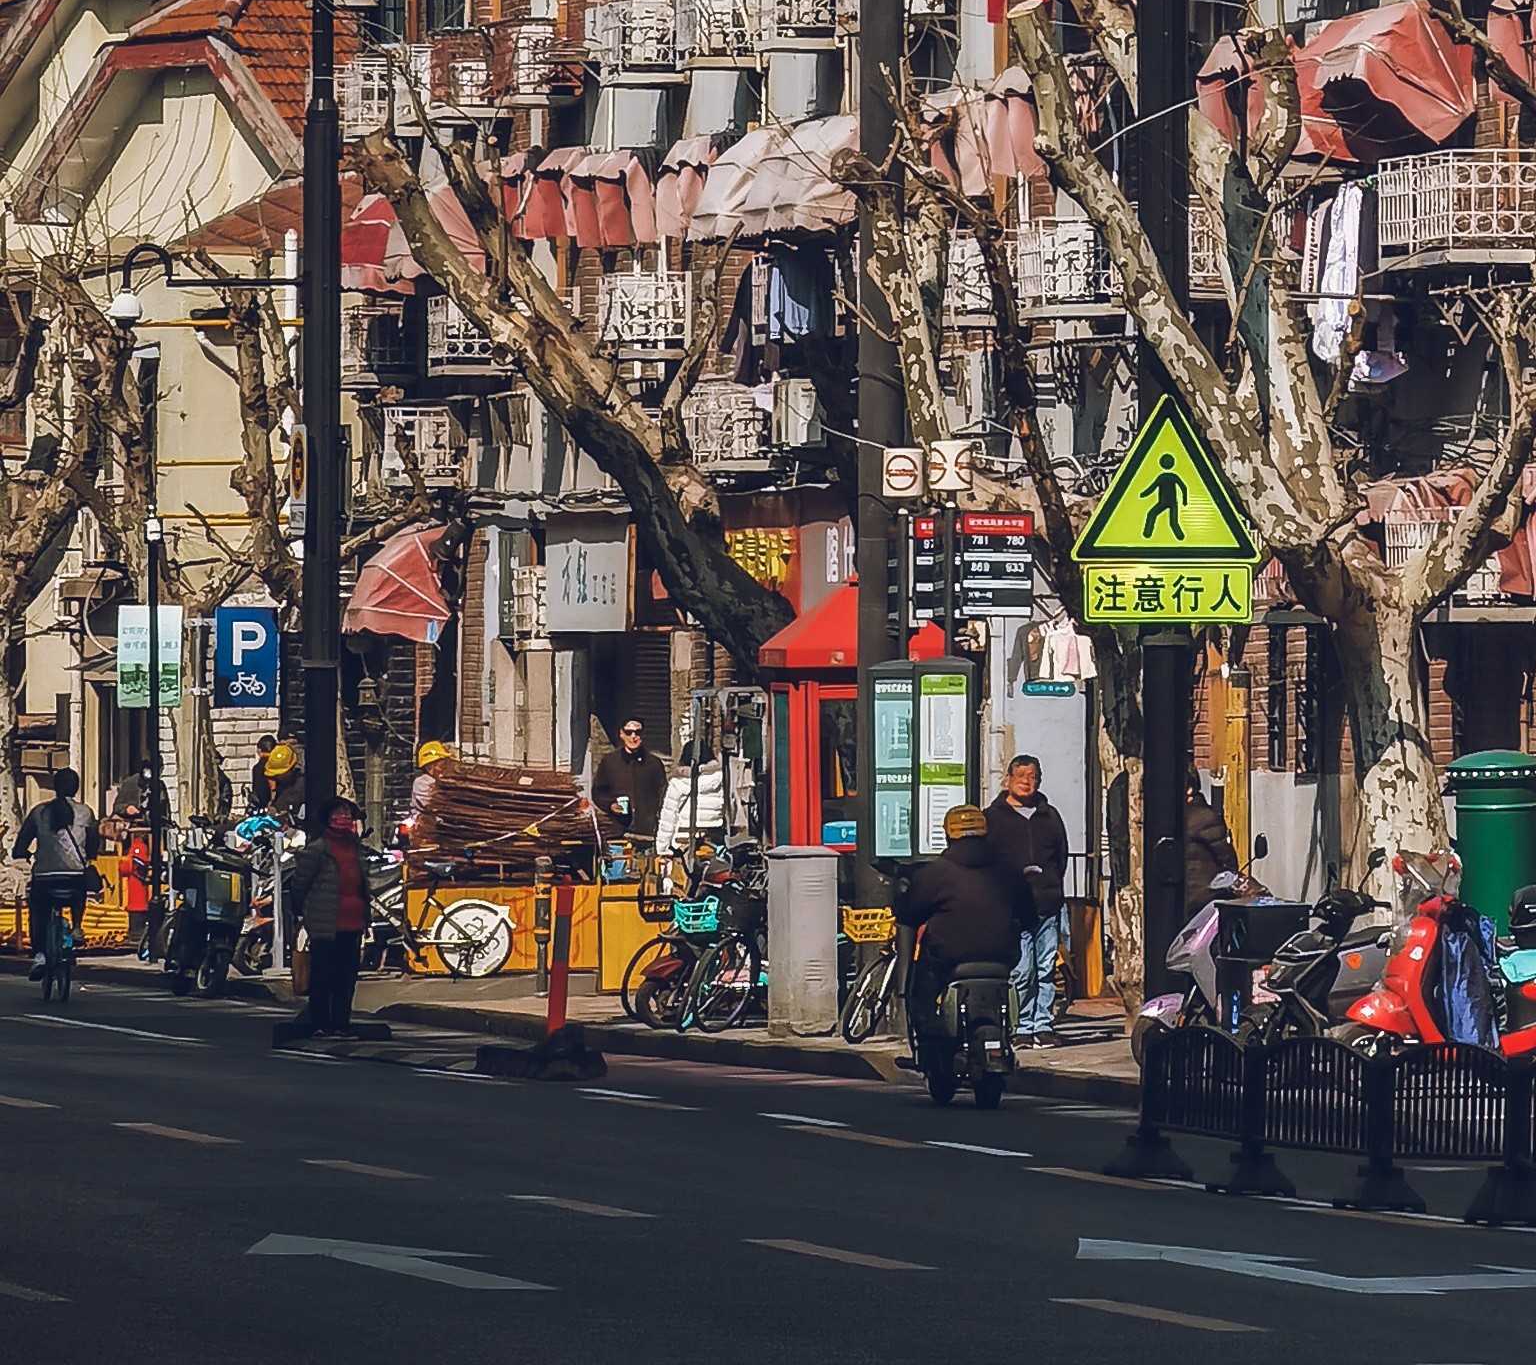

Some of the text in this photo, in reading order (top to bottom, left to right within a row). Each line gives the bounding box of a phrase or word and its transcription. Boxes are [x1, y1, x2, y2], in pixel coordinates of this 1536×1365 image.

[1094, 574, 1243, 613] 注意行人
[232, 621, 267, 666] P
